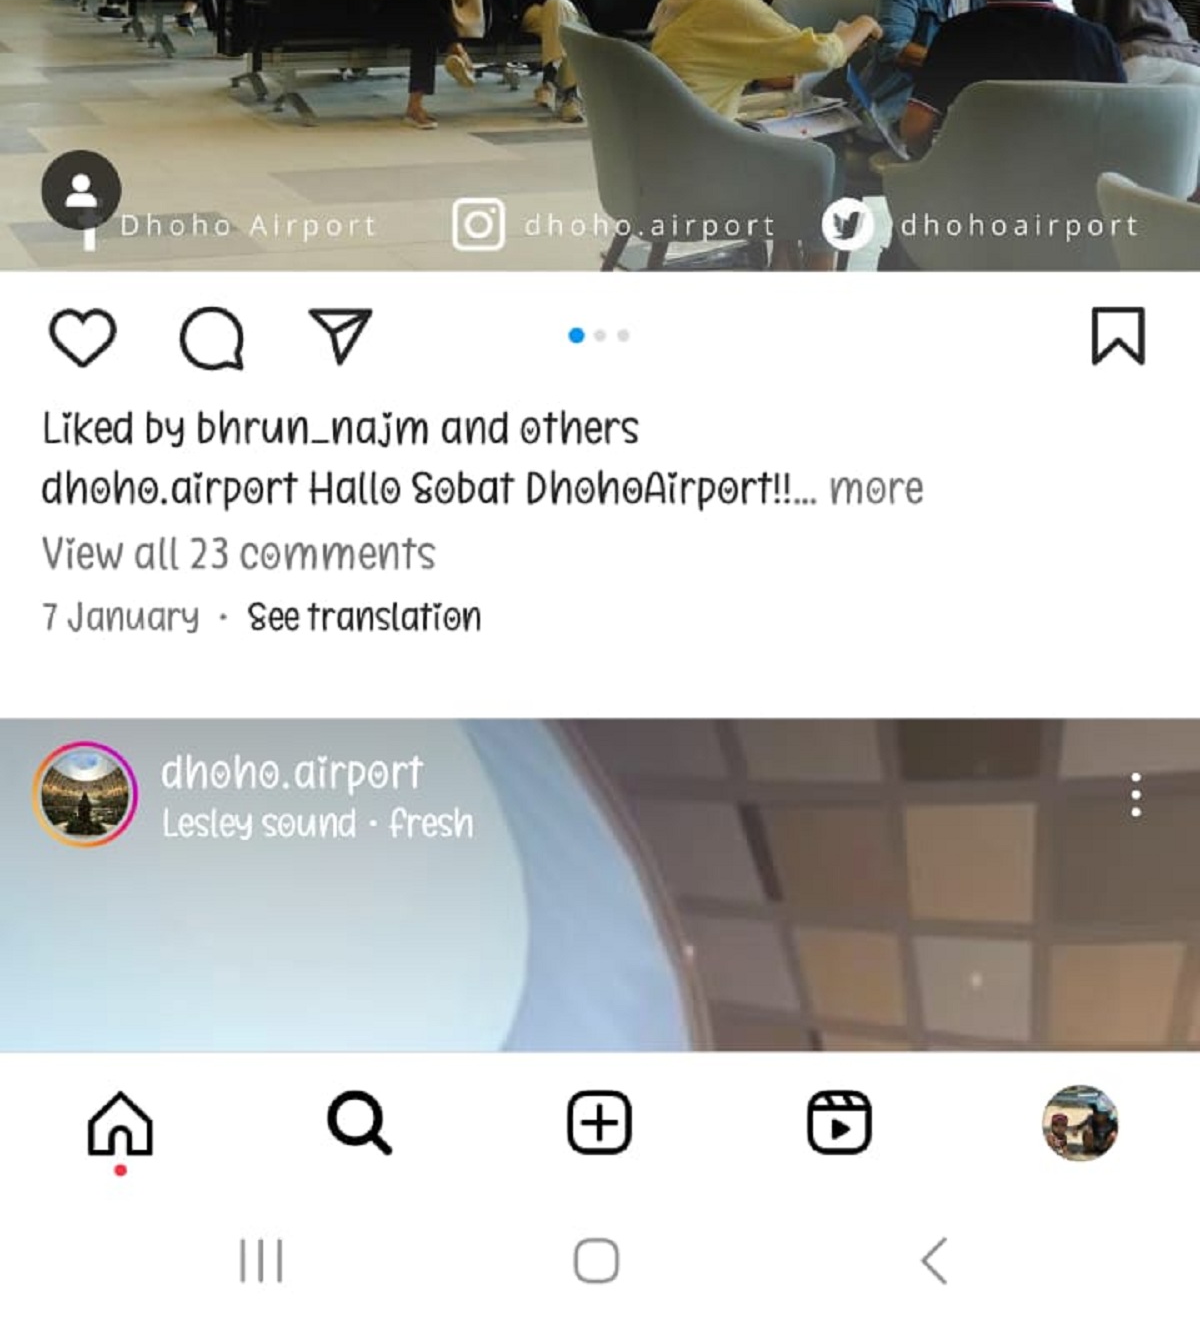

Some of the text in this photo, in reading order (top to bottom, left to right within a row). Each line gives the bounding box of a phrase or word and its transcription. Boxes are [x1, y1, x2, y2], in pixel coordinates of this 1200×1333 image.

[43, 410, 640, 449] Liked by bhrun_najm and others
[42, 470, 299, 511] dhoho.airport
[308, 470, 402, 505] Hallo
[412, 470, 516, 505] Sobat
[830, 477, 924, 505] more
[42, 537, 436, 571] View all 23 comments
[42, 602, 482, 634] 7 January See translation
[161, 755, 424, 795] dhoho.airport
[163, 808, 474, 840] Lesley sound fresh
